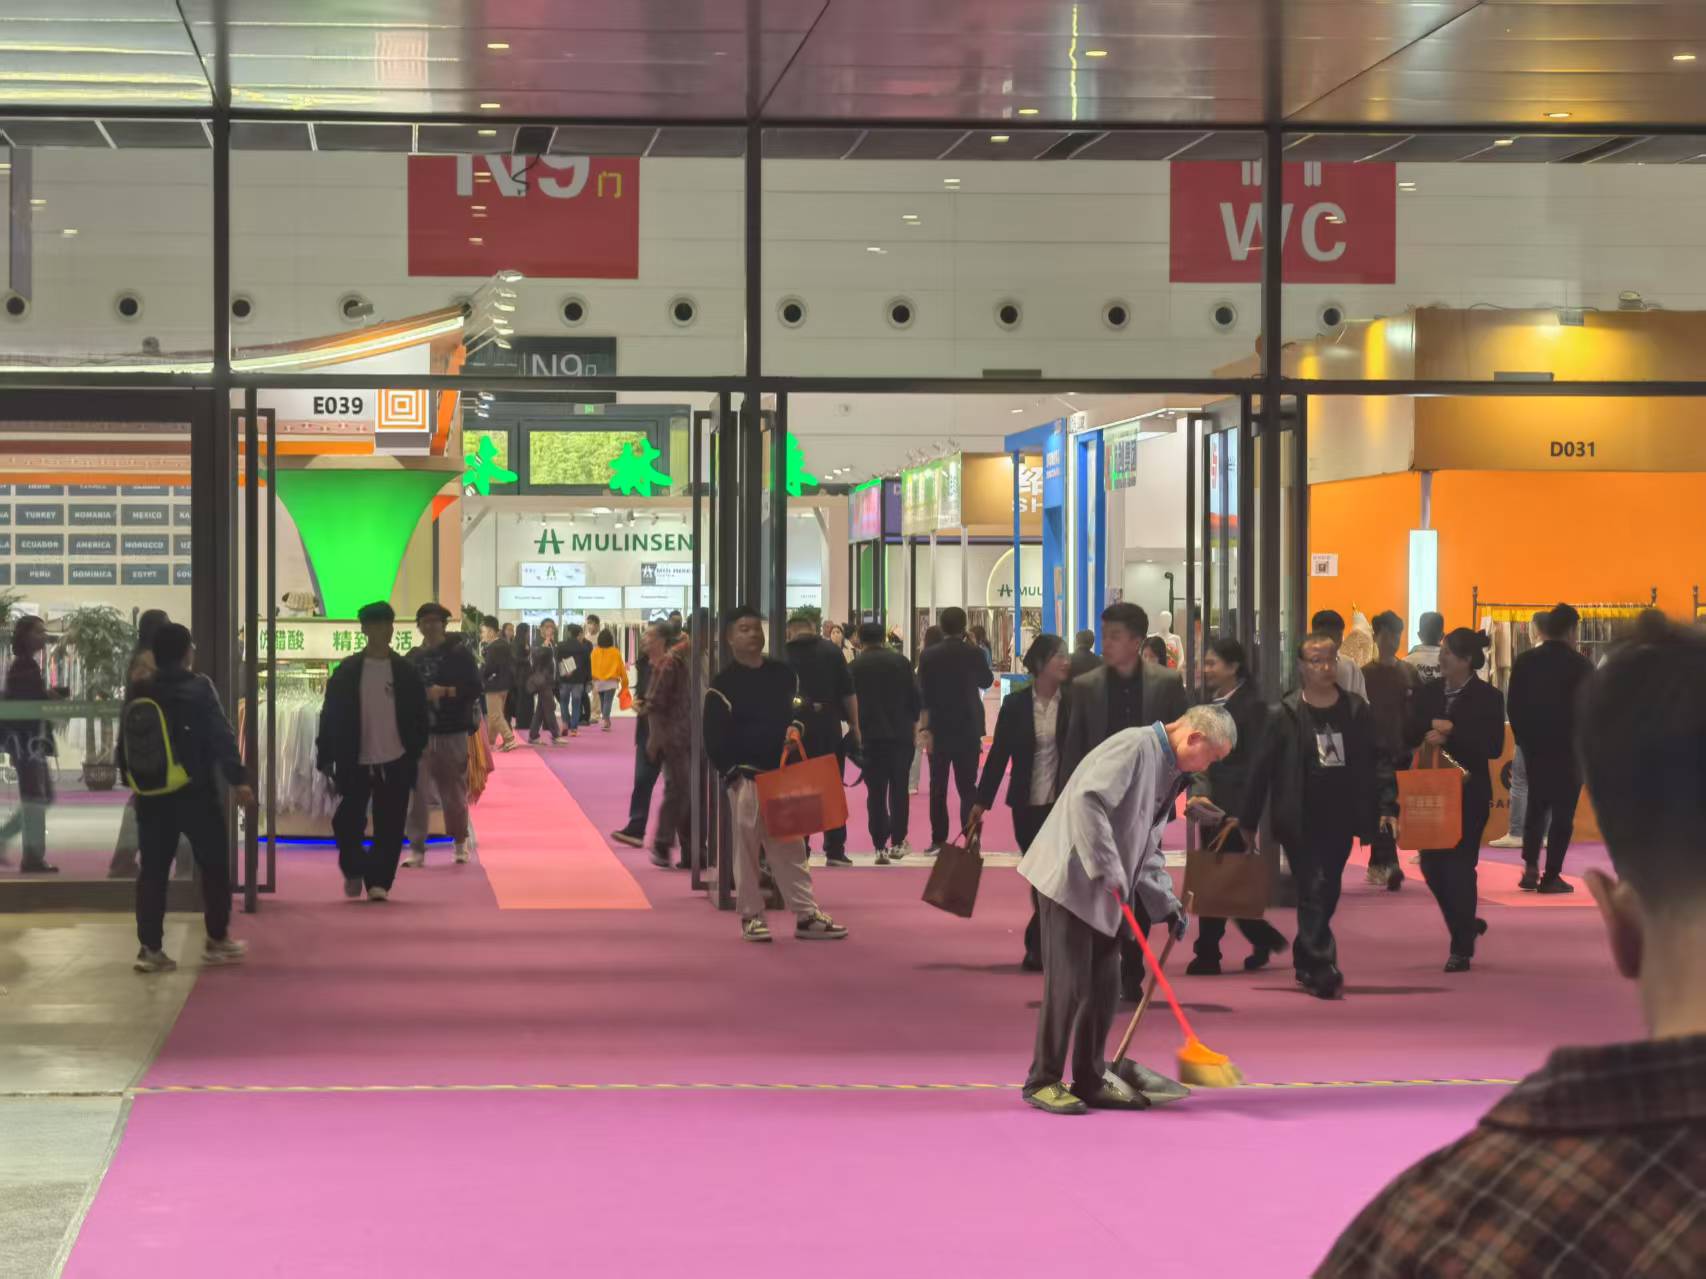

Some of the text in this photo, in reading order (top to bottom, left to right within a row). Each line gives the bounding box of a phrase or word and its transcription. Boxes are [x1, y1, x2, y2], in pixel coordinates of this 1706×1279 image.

[1219, 201, 1347, 263] WC
[313, 396, 363, 415] E039
[1550, 441, 1596, 457] D031
[25, 511, 56, 520] TURKEY
[132, 511, 162, 520] MEXICO
[21, 541, 59, 549] ECUADOR
[76, 541, 111, 549] AMERICA
[572, 533, 693, 551] MULINSEN
[29, 570, 51, 578] PERU
[132, 570, 157, 578] EGYPT
